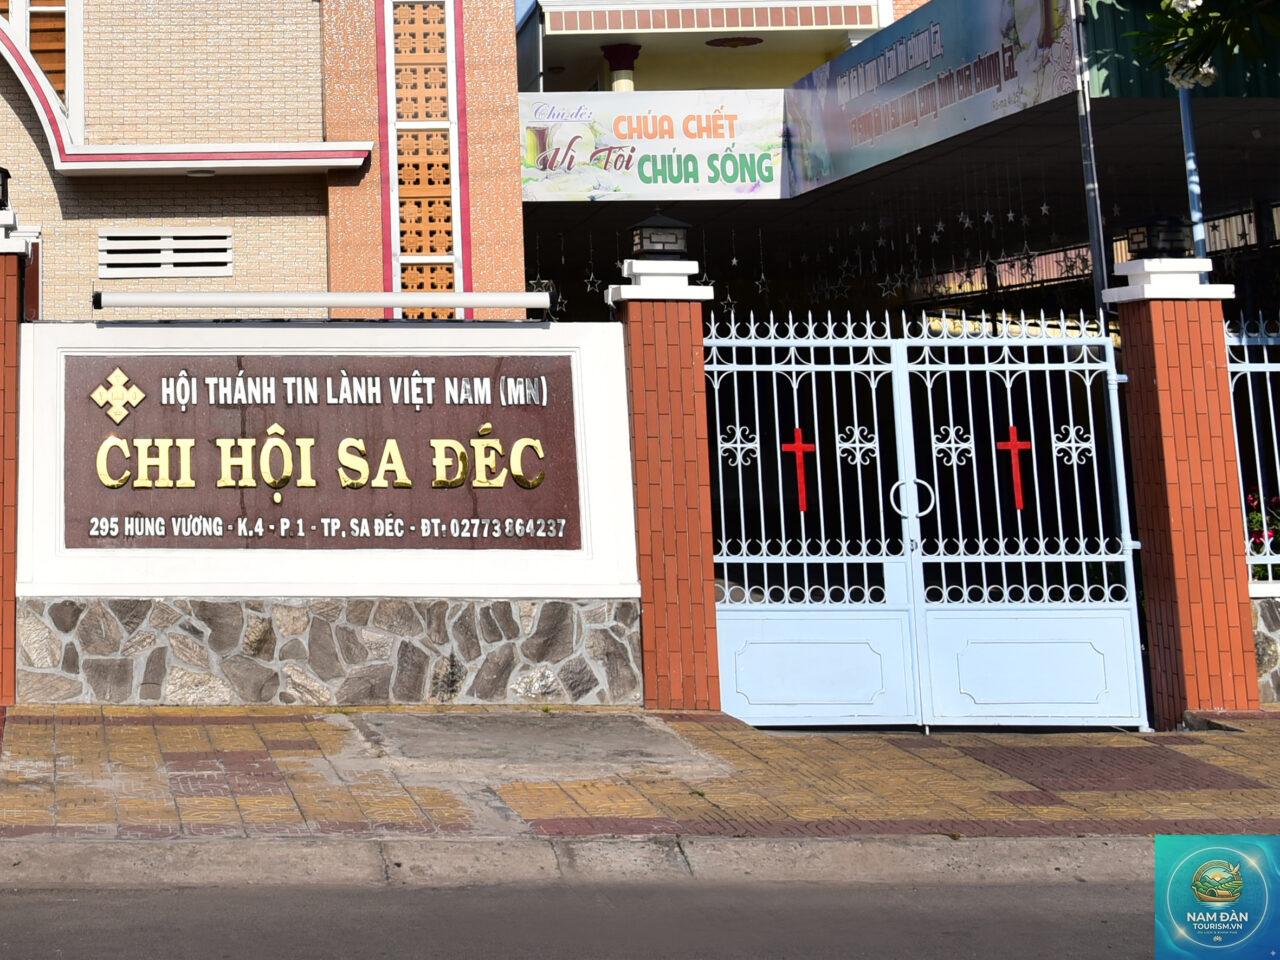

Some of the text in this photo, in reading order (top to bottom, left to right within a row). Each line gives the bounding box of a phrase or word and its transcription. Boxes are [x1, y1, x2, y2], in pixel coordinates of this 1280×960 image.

[612, 105, 738, 140] CHÚA CHẾT
[536, 135, 636, 171] Vì Tôi
[637, 143, 773, 184] CHÚA SỐNG
[161, 370, 548, 412] HỘI THÁNH TIN LÀNH VIỆT NAM (MN)
[96, 422, 546, 504] CHI HỘI SA ĐÉC
[89, 516, 119, 537] 295
[171, 514, 223, 537] VƯƠNG
[237, 517, 265, 537] K.4
[351, 518, 370, 537] SA
[374, 513, 405, 537] ĐÉC
